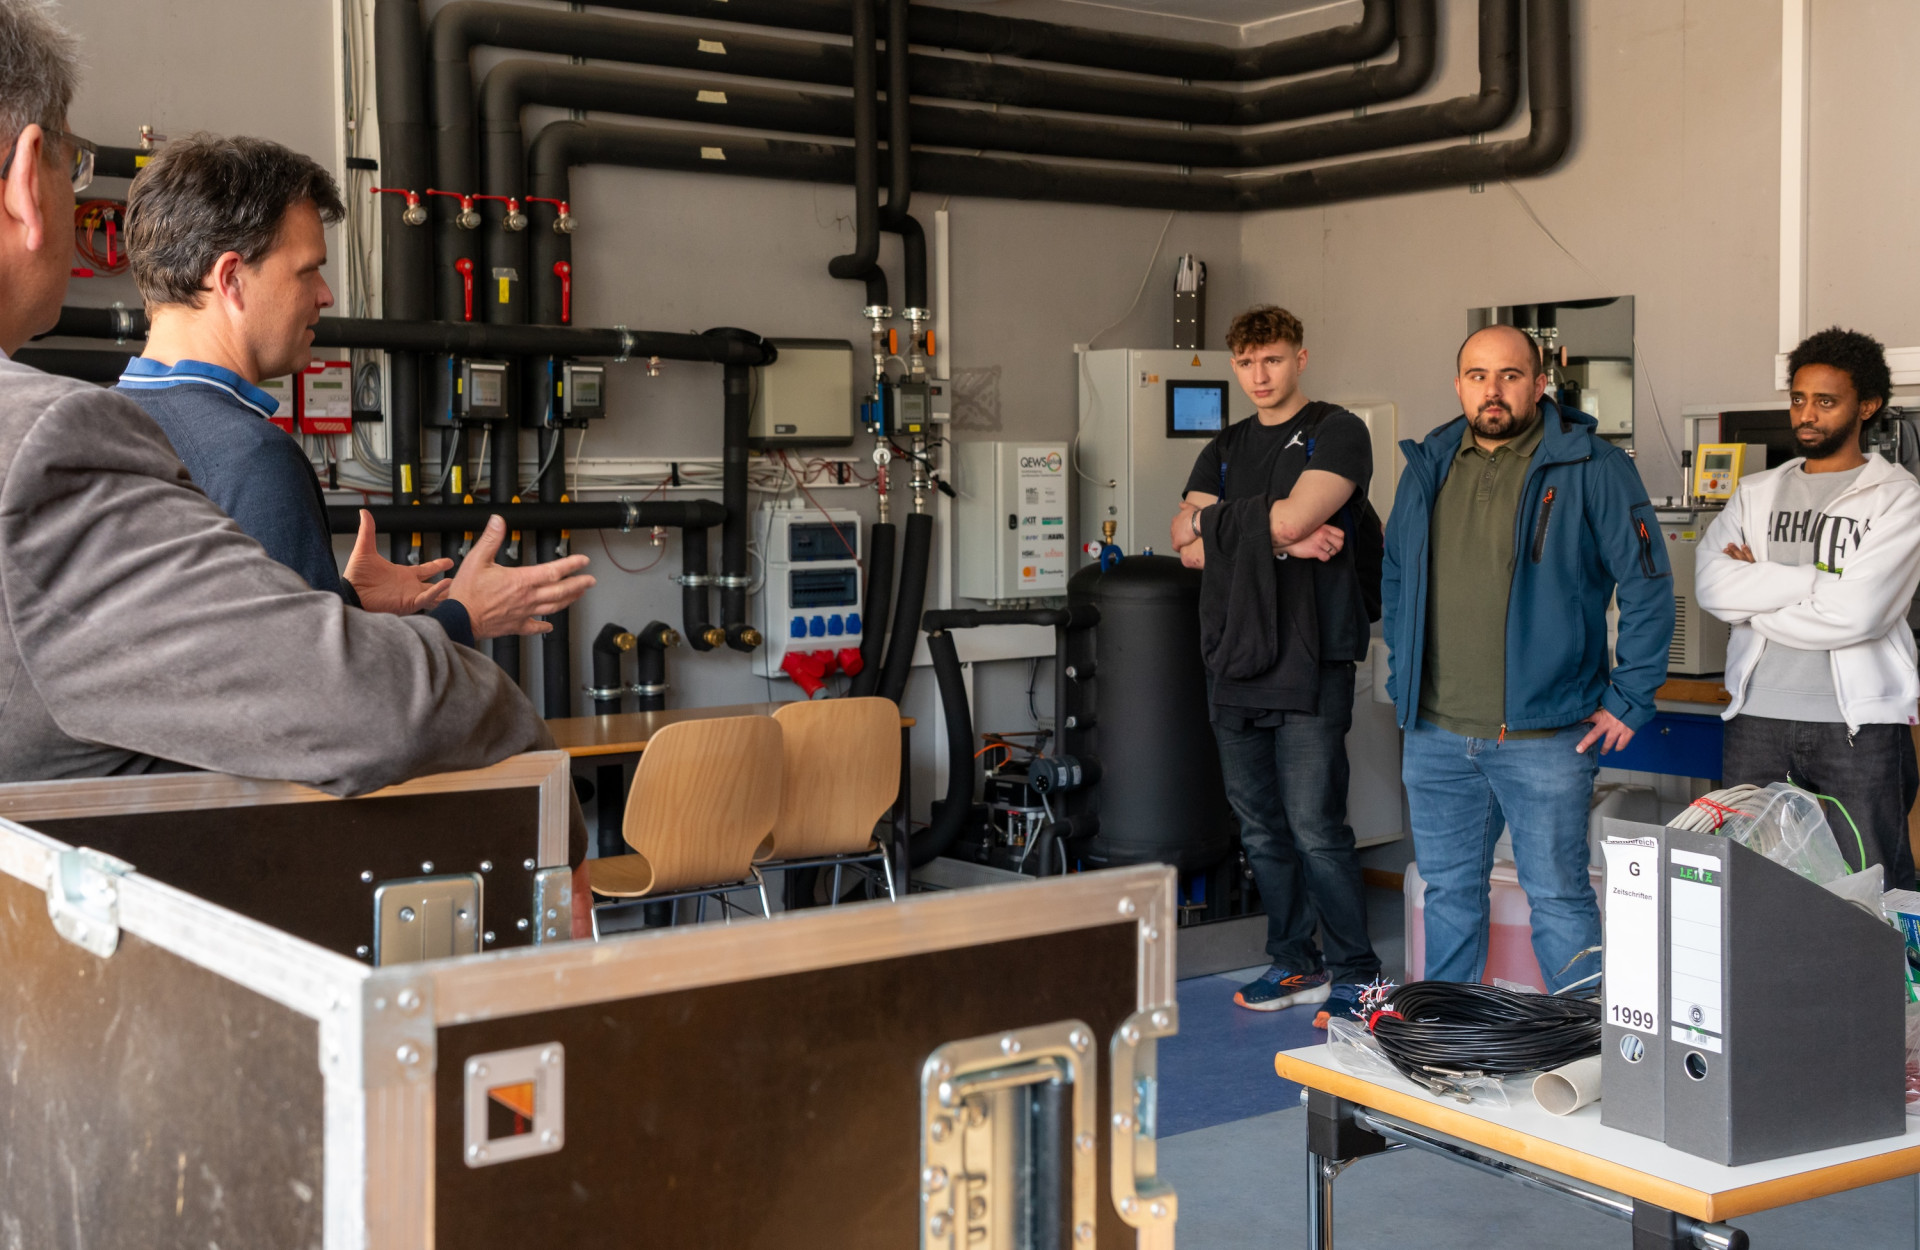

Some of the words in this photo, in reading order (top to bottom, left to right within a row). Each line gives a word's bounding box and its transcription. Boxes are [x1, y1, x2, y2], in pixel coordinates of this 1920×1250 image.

[1020, 456, 1047, 468] QEWS
[1629, 861, 1640, 876] G
[1612, 887, 1653, 901] Zeitschriften
[1612, 1004, 1654, 1030] 1999
